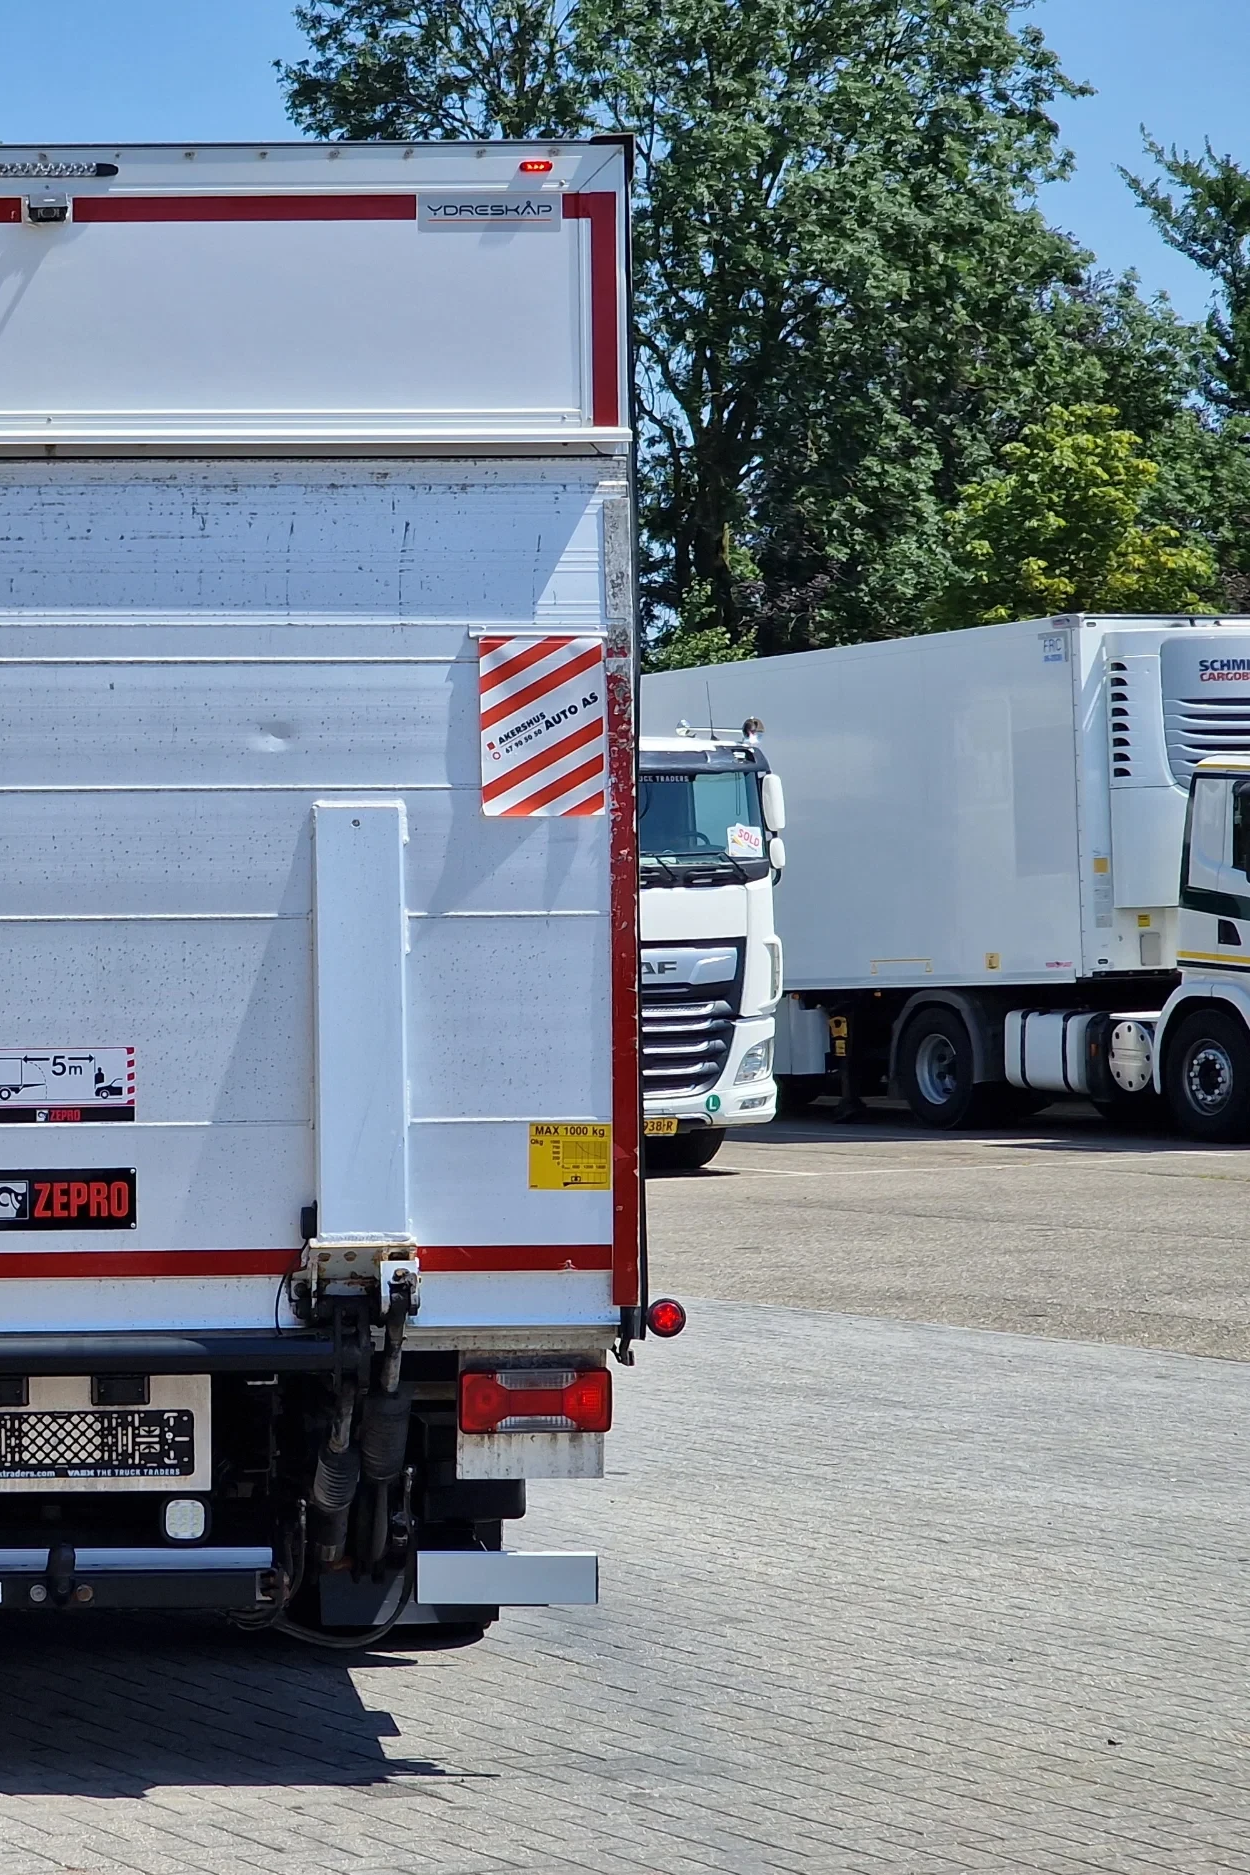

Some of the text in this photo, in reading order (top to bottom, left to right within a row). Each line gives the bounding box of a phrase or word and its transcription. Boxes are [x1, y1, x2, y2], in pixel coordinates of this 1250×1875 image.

[544, 692, 599, 731] AUTO AS
[498, 712, 546, 745] AKERSHUS
[737, 828, 760, 847] SOLD
[709, 1098, 717, 1110] L
[50, 1110, 81, 1121] ZEPRO
[535, 1126, 605, 1138] MAX 1000 kg
[34, 1181, 129, 1218] ZEPRO
